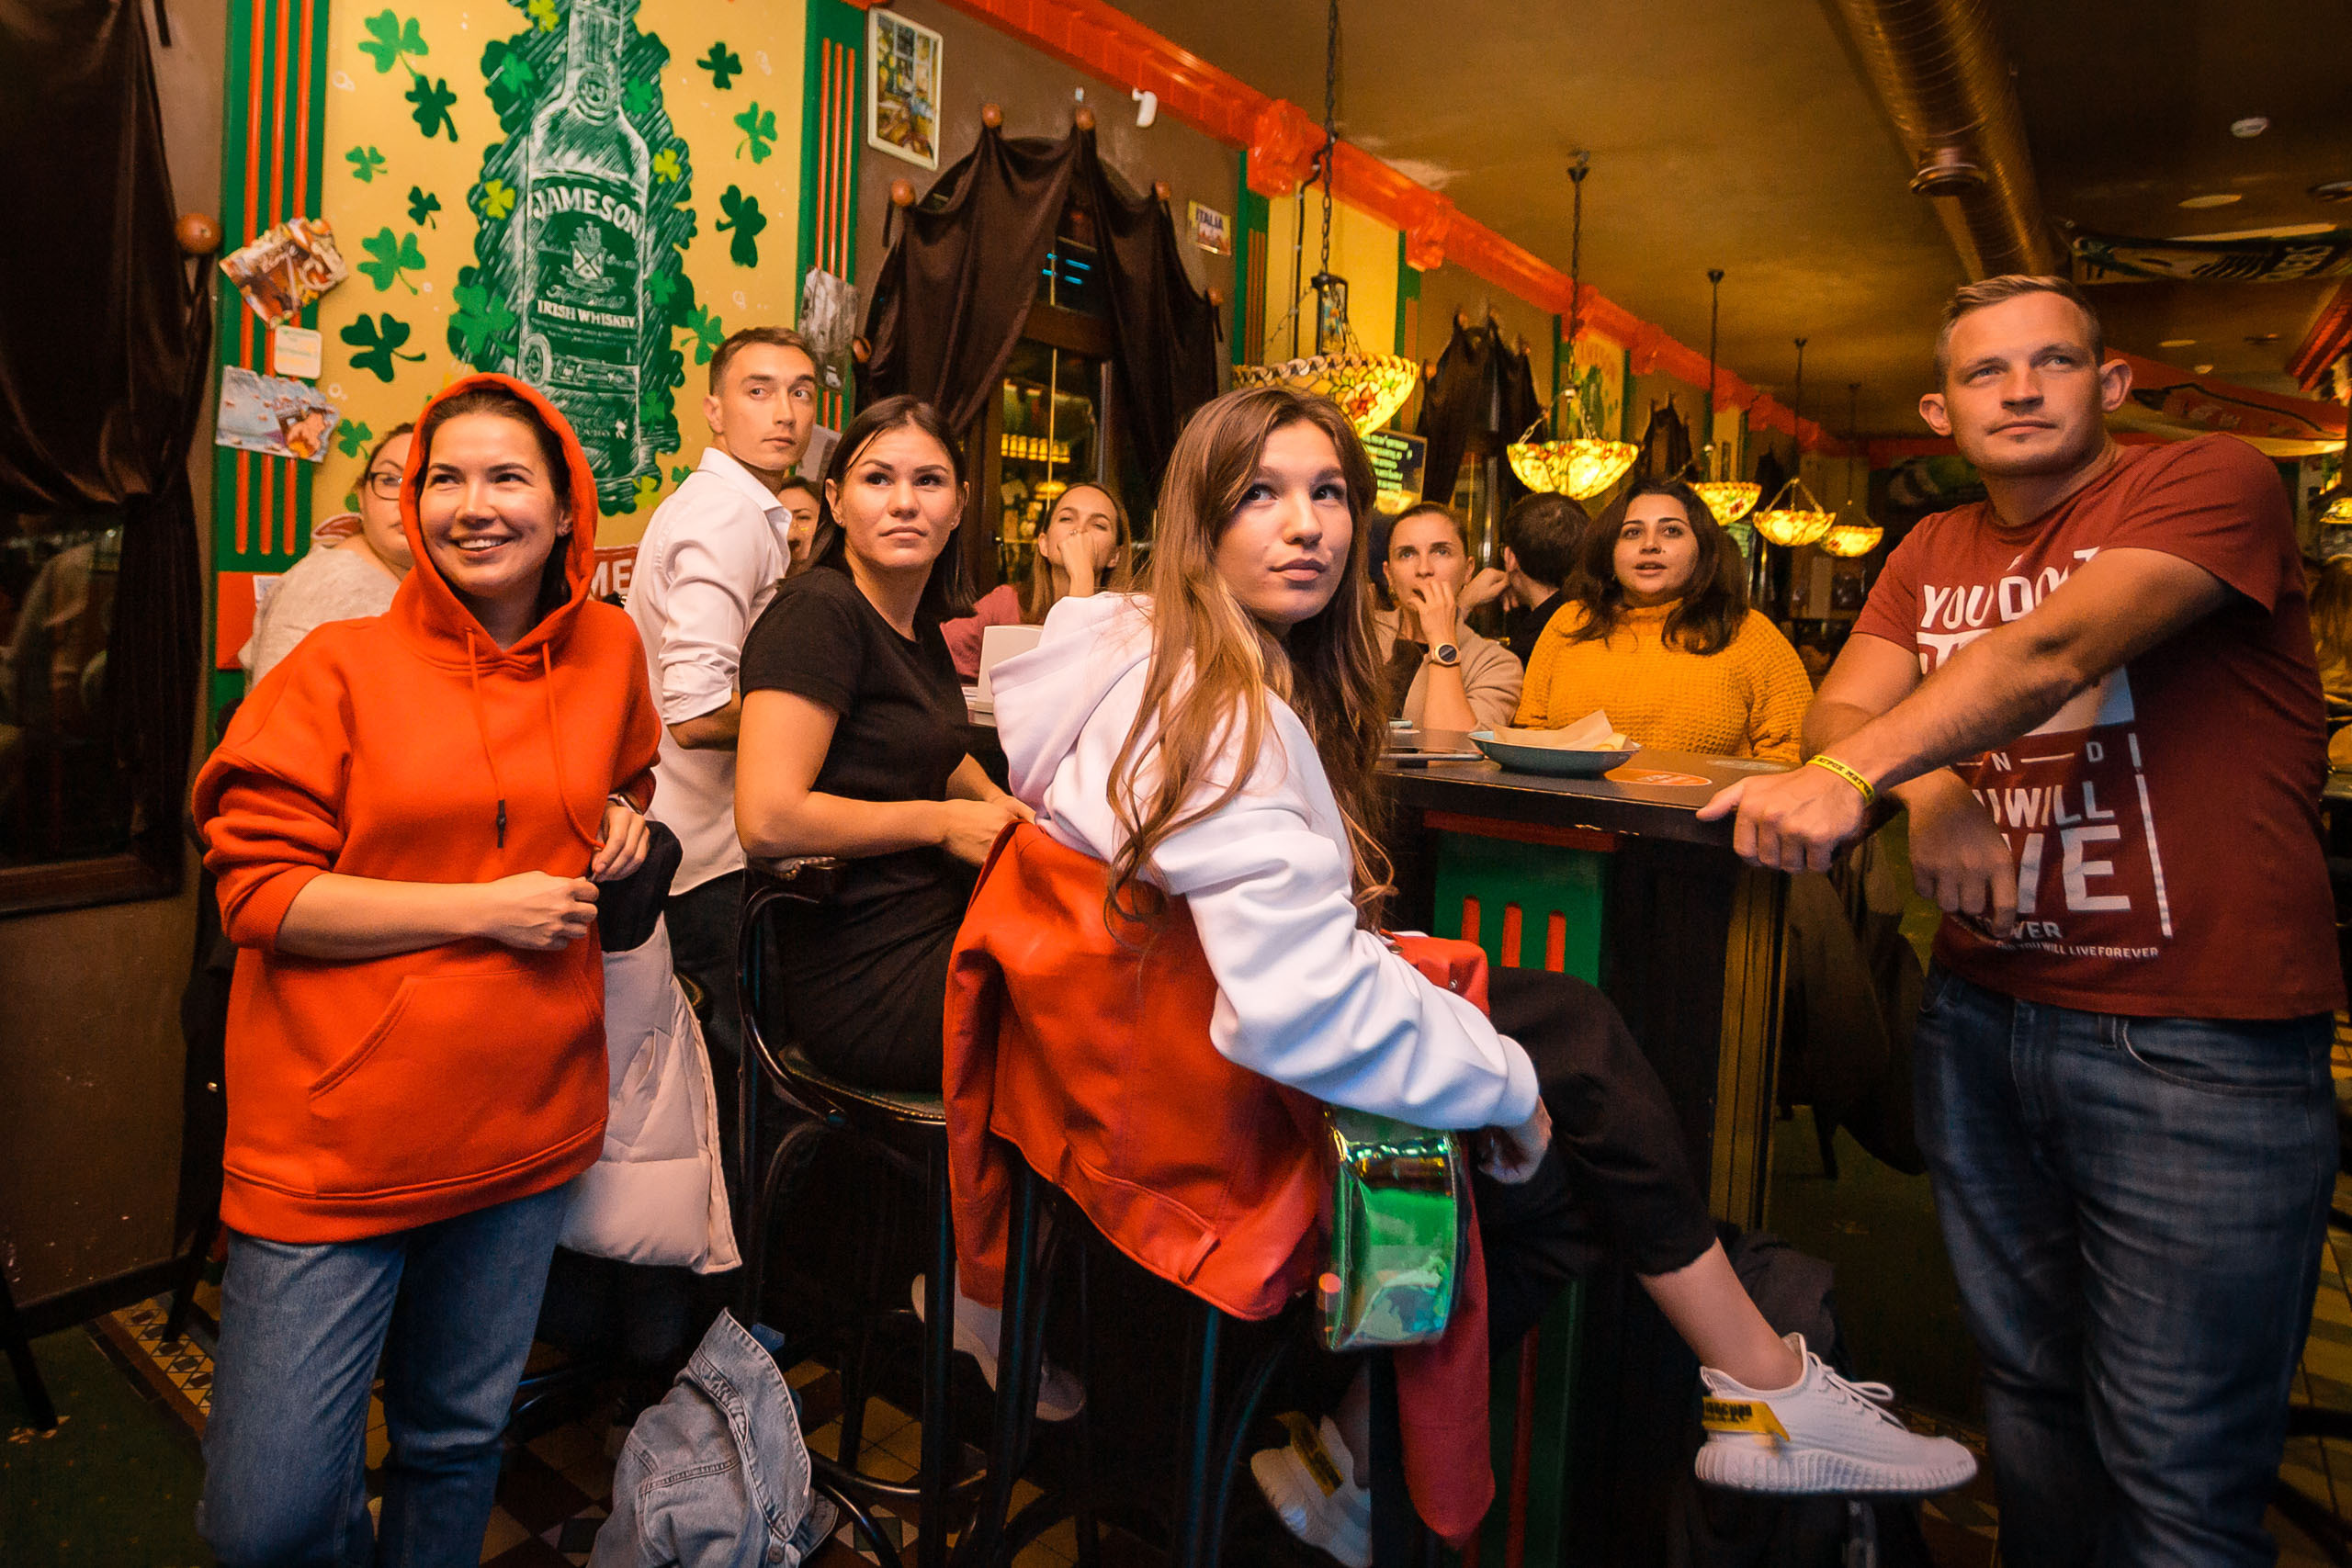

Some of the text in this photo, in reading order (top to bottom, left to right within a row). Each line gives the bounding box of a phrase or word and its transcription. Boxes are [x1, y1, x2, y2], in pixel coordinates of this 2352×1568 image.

[532, 186, 641, 240] JAMESON
[537, 299, 635, 329] IRISH WHISKEY
